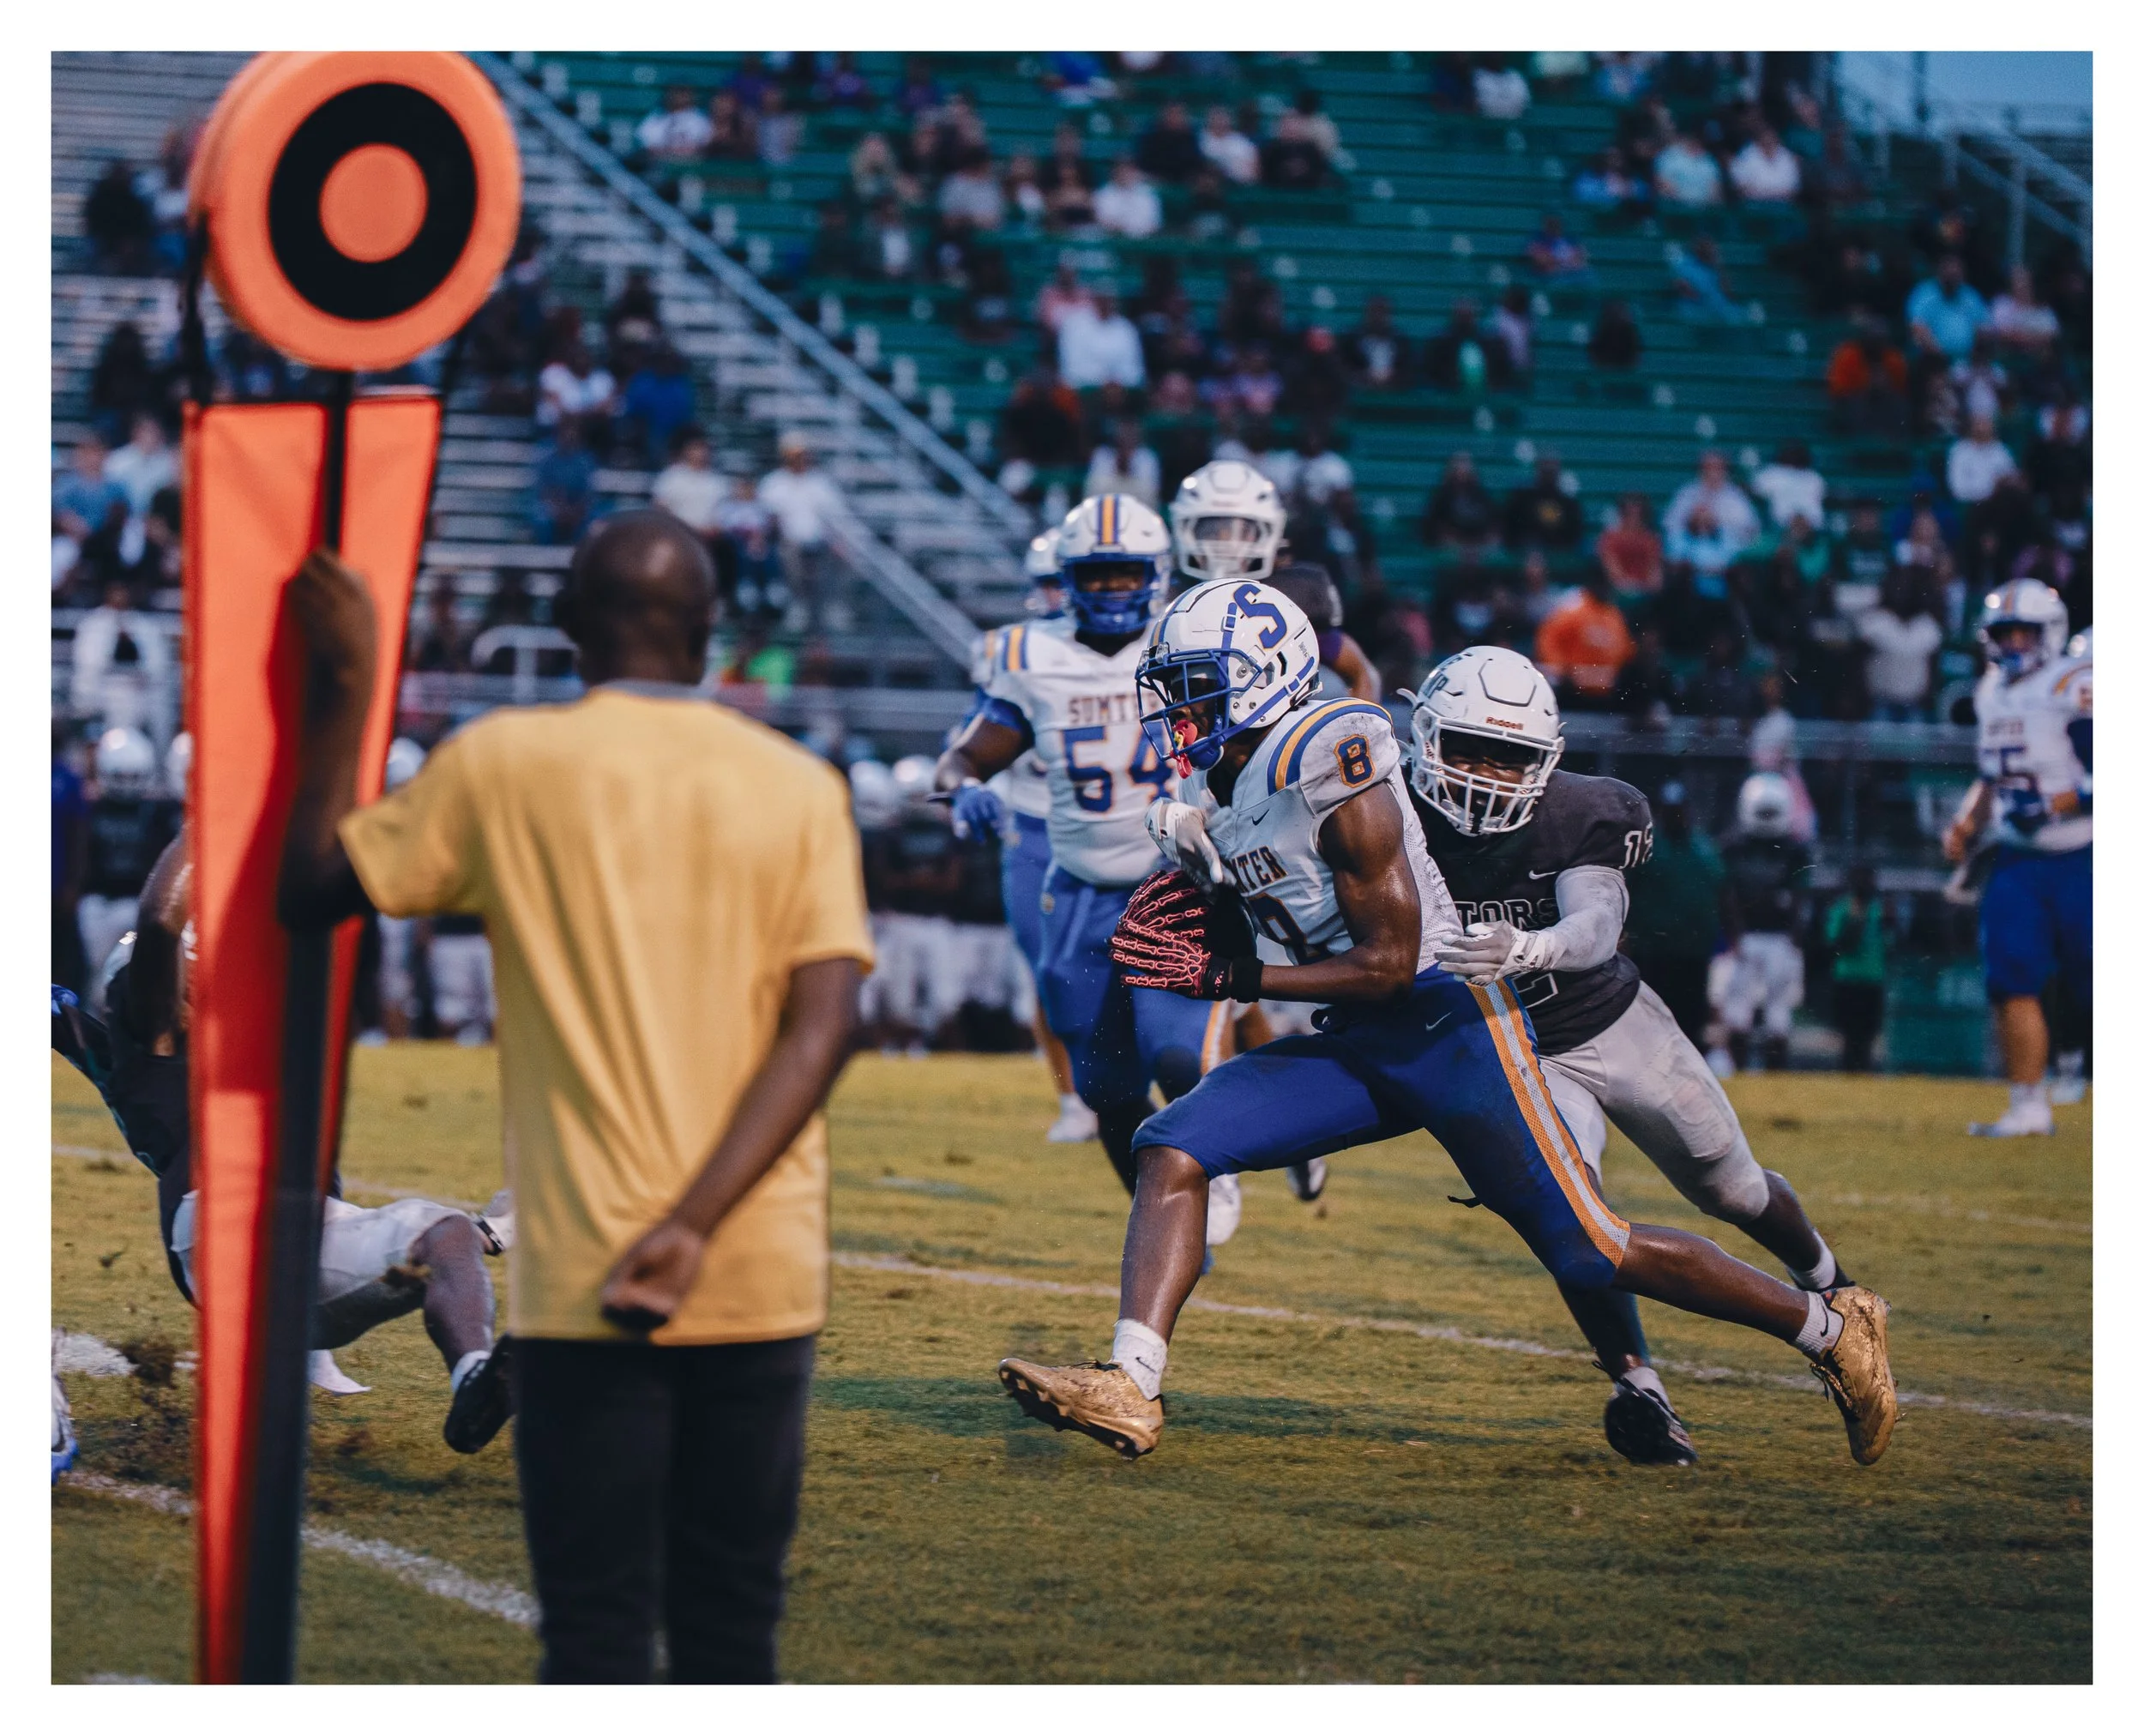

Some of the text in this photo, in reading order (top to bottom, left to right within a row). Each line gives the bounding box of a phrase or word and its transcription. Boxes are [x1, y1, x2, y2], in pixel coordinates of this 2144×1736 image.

[1233, 583, 1287, 648] S
[1485, 717, 1524, 731] Riddell
[1061, 721, 1174, 815] 54
[1334, 733, 1376, 788] 8
